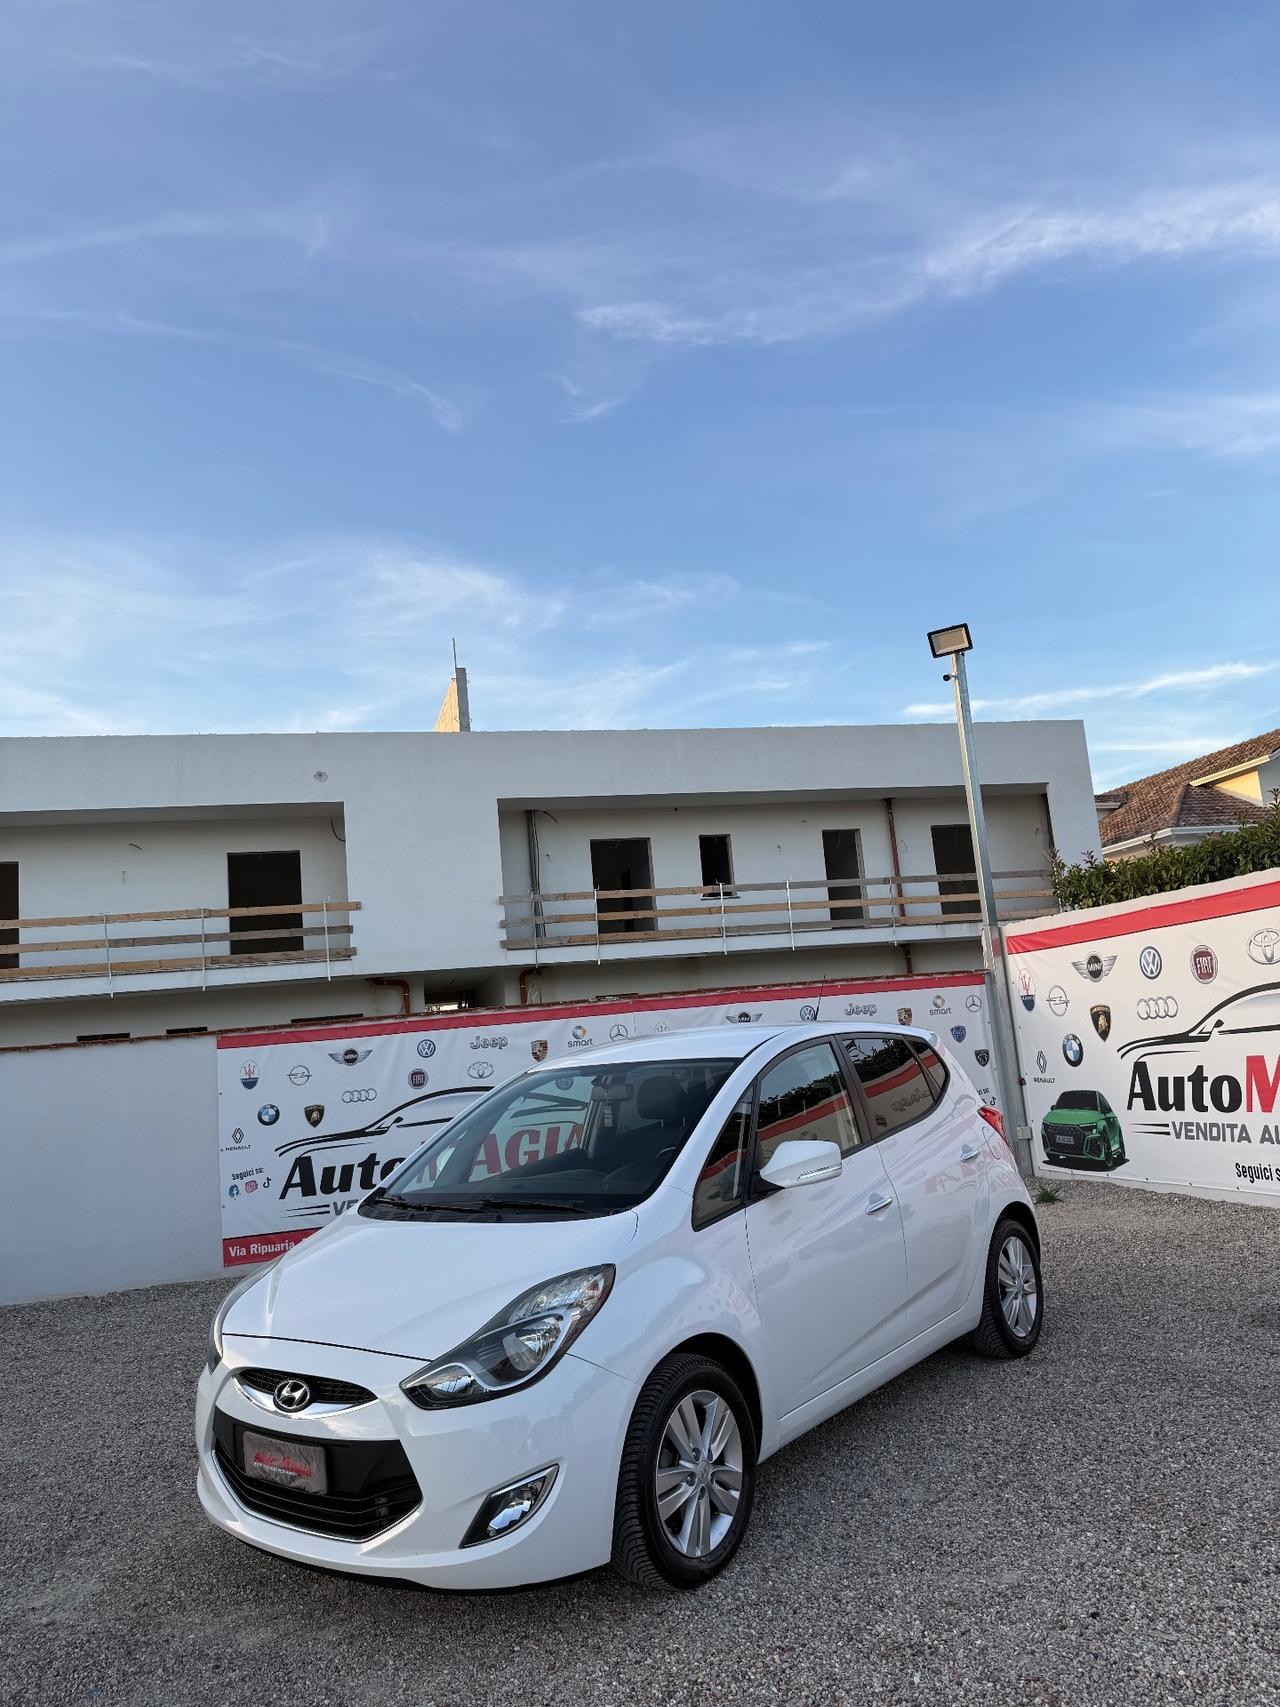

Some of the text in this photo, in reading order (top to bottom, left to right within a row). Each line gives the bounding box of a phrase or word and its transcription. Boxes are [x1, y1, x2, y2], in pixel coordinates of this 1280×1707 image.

[1195, 956, 1213, 975] FIAT
[844, 1002, 878, 1017] Jeep
[929, 1007, 952, 1016] smart
[469, 1035, 508, 1050] Jeep
[567, 1038, 593, 1048] smart
[411, 1074, 425, 1085] FIAT
[1171, 1121, 1252, 1144] VENDITA
[1235, 1162, 1273, 1184] Seguici
[229, 1239, 296, 1257] Via Ripuaria
